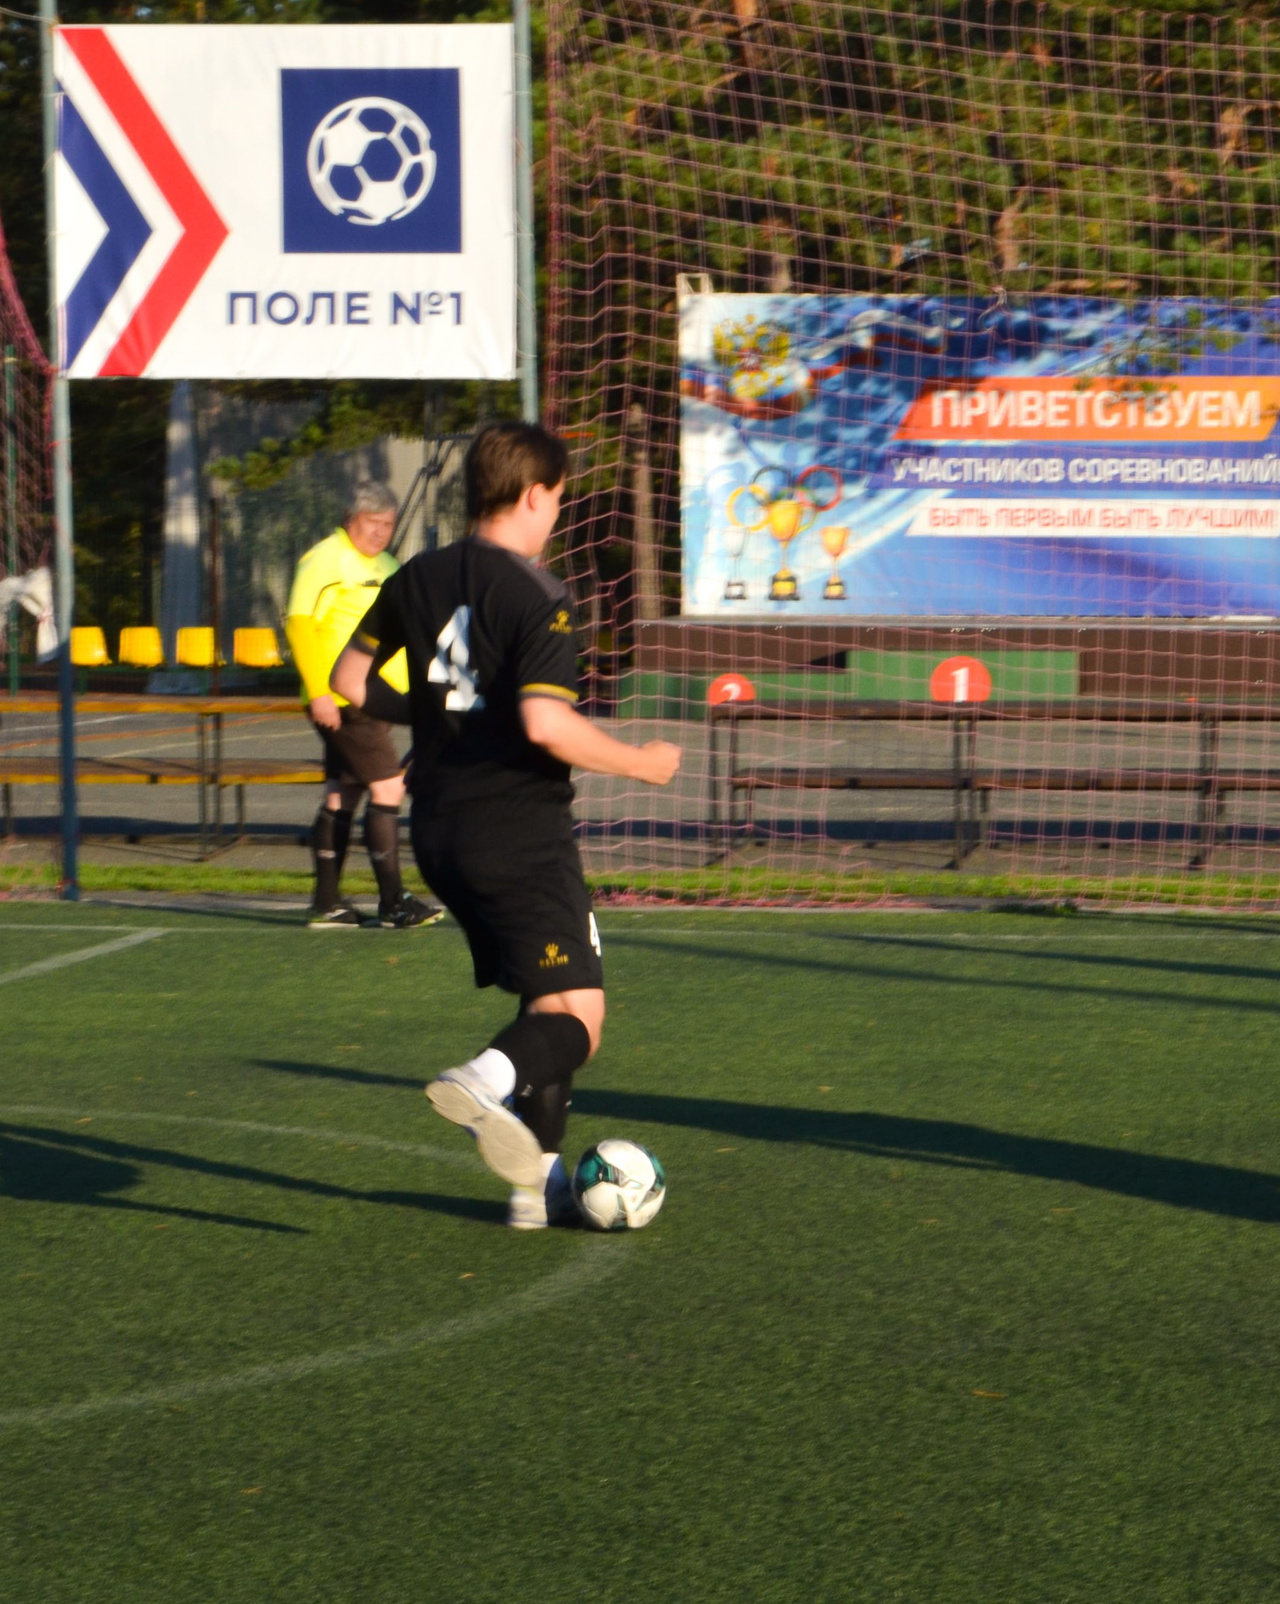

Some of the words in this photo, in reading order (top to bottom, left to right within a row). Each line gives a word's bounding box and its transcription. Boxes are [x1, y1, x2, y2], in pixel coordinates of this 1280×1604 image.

[227, 291, 371, 325] ПОЛЕ
[931, 390, 1262, 428] ПРИВЕТСТВУЕМ
[892, 457, 1066, 483] УЧАСТНИКОВ
[929, 507, 990, 527] БЫТЬ
[1098, 508, 1160, 528] БЫТЬ
[1166, 508, 1276, 528] ЛУЧШИМ!
[427, 605, 486, 711] 4
[951, 666, 969, 703] 1
